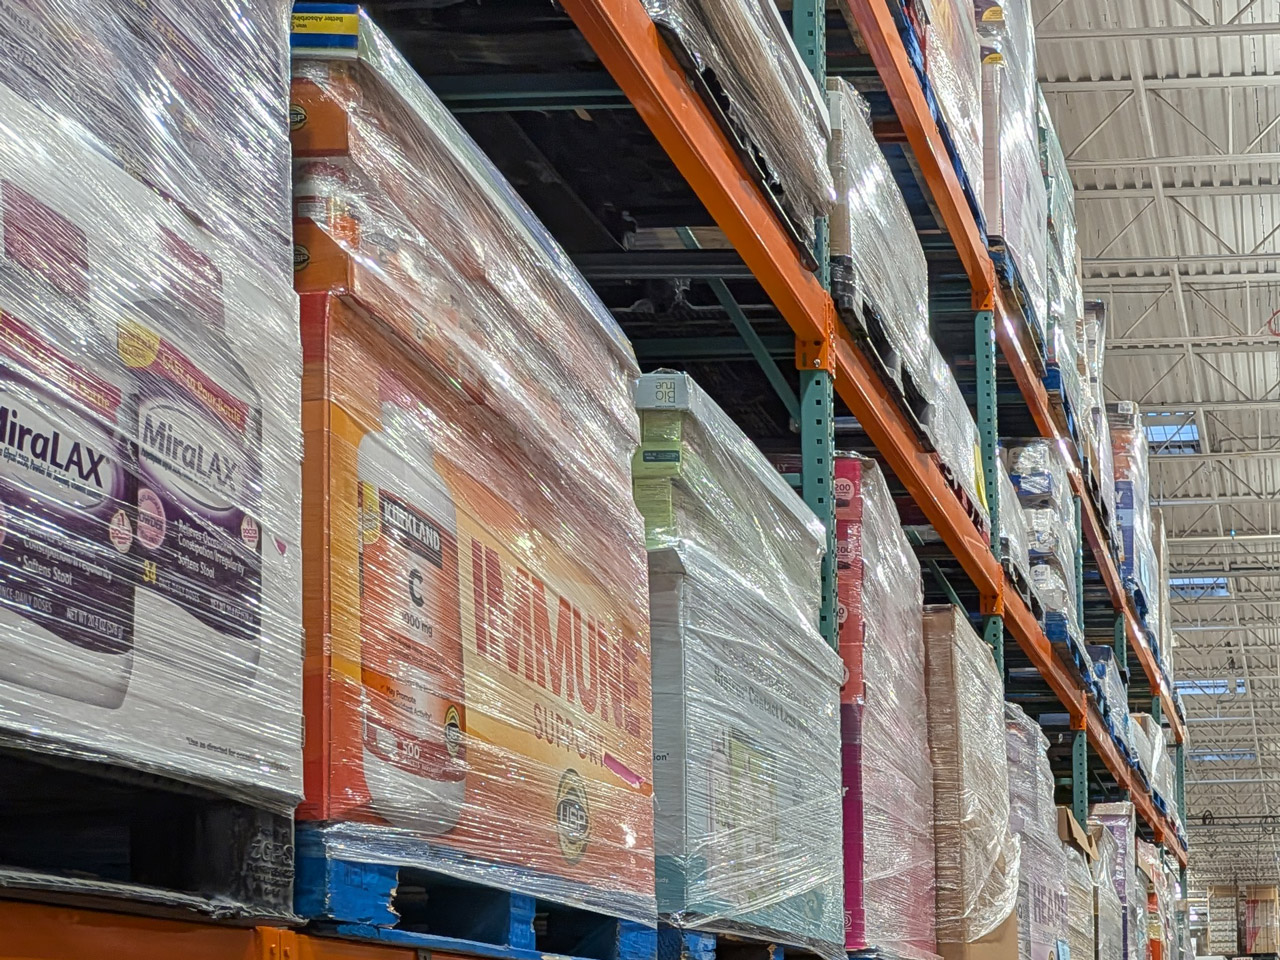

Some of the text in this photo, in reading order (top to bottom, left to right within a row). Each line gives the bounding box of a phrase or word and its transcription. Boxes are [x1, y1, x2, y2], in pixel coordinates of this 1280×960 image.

[142, 412, 238, 491] MiraLAX
[382, 501, 441, 552] KIRKLAND
[22, 556, 73, 586] Softens Stool
[200, 561, 215, 579] Stool
[408, 568, 424, 608] C
[471, 538, 641, 738] IMMUNE
